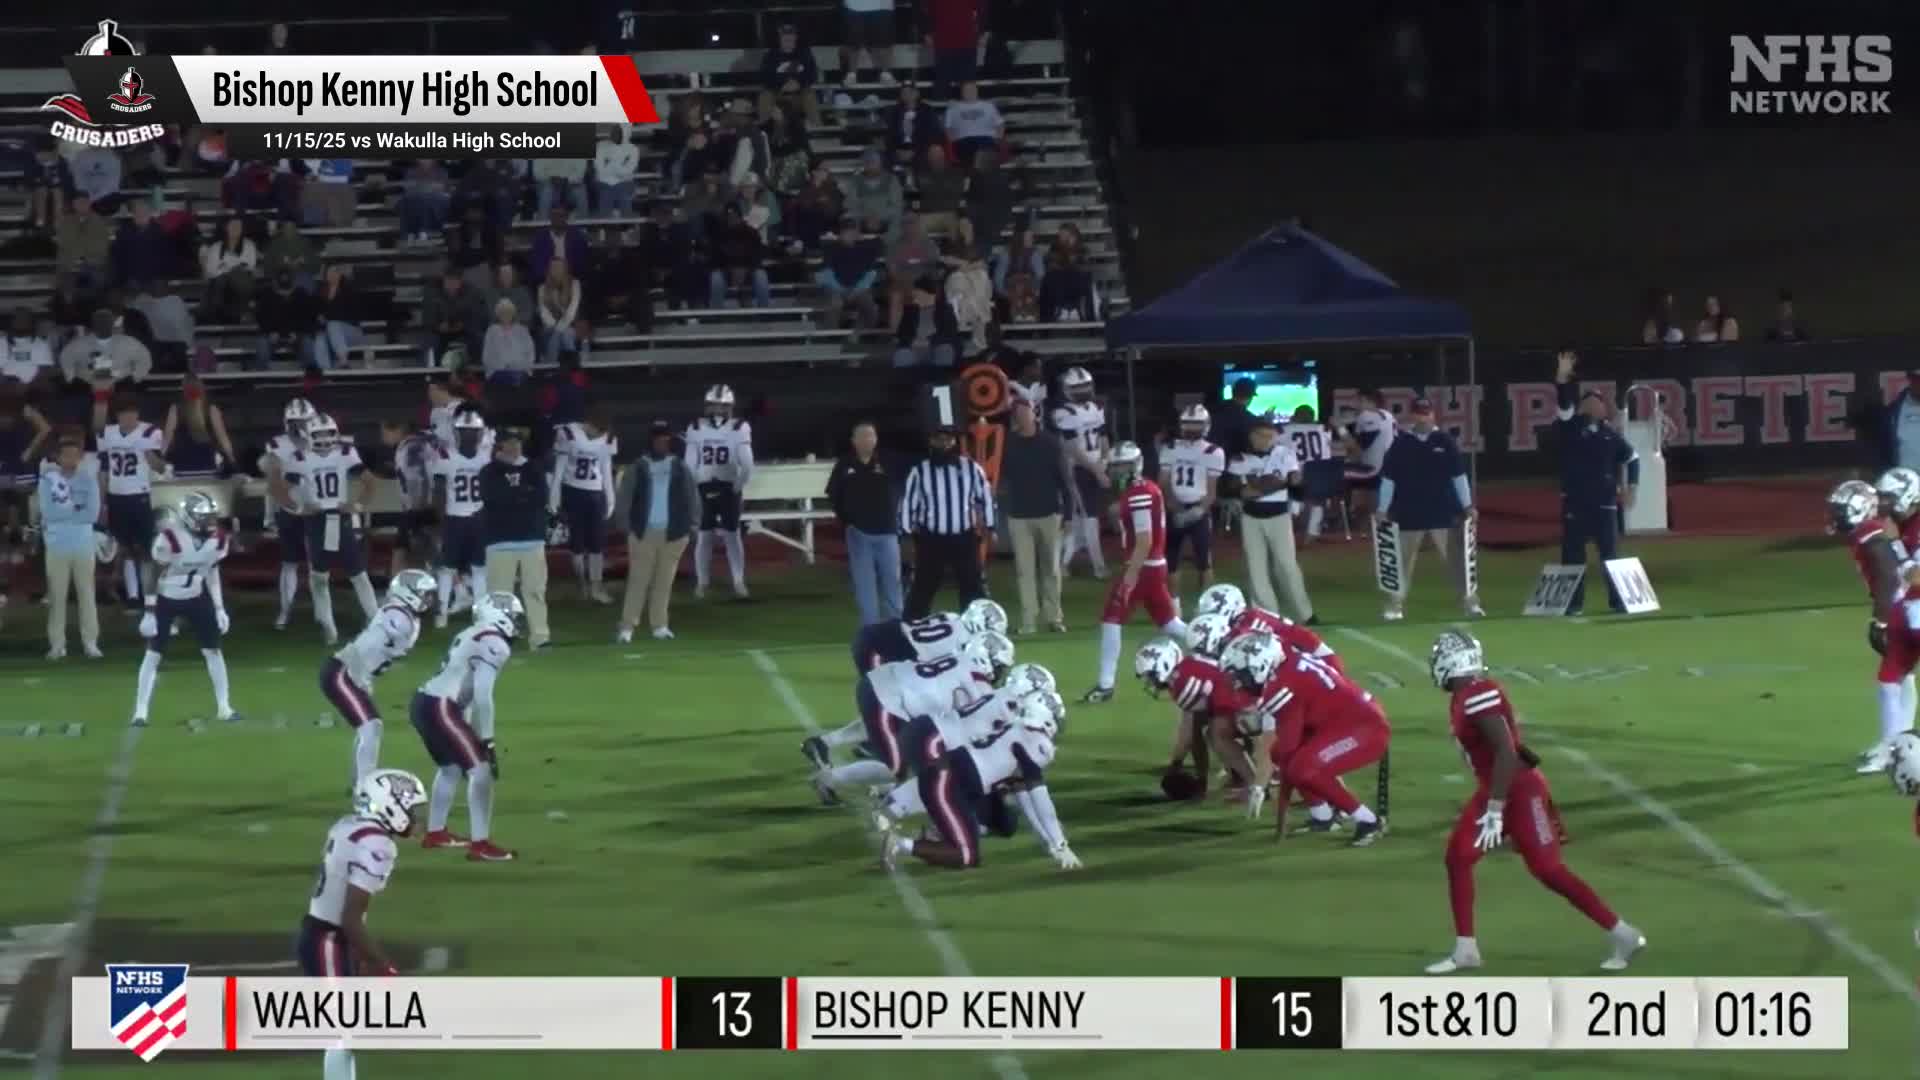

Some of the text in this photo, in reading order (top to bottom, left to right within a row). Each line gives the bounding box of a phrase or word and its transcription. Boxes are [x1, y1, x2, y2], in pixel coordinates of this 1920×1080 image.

[931, 385, 954, 426] 1
[1291, 430, 1322, 461] 30
[111, 452, 138, 476] 32
[1176, 465, 1195, 487] 11
[315, 471, 339, 499] 10
